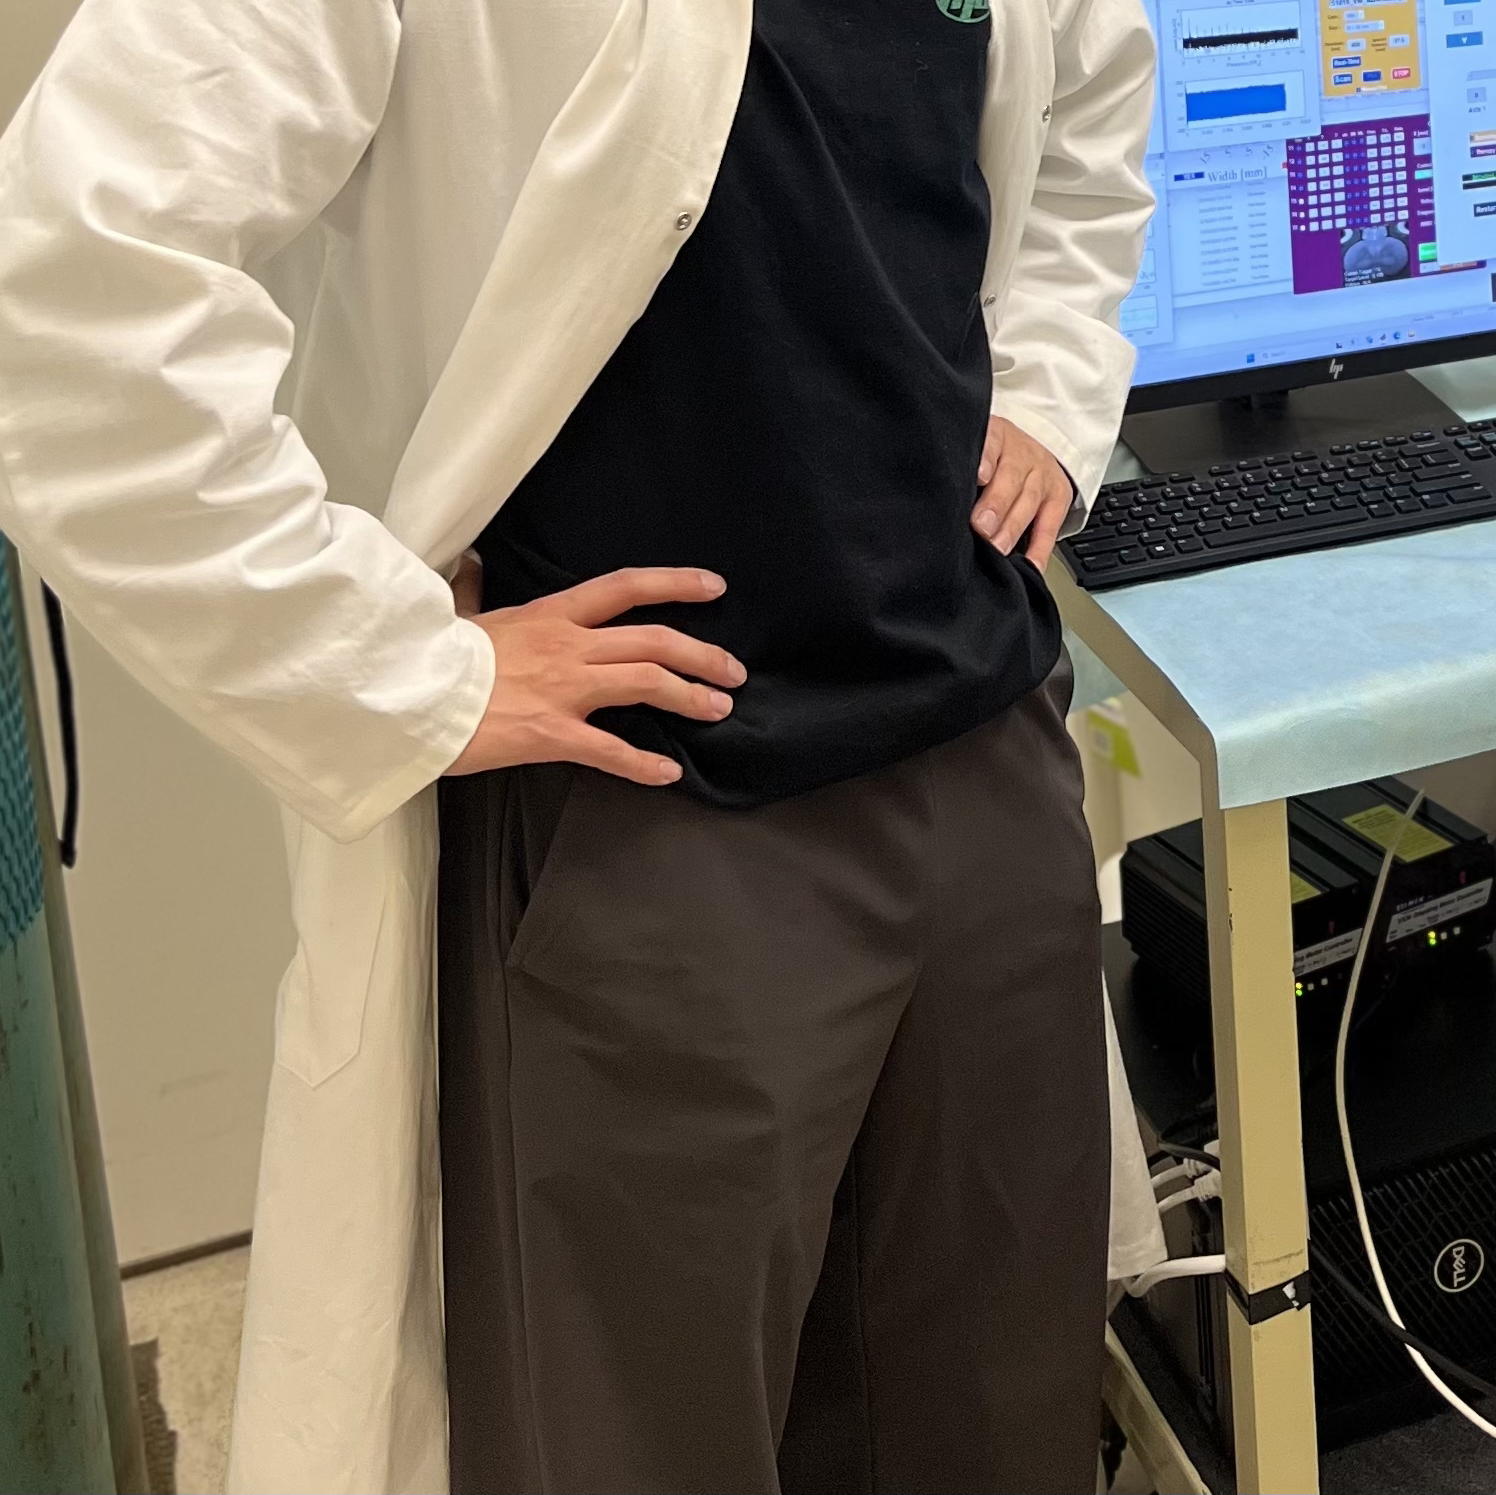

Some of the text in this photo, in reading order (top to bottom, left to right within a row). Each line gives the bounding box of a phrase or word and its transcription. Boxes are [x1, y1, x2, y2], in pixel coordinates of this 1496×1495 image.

[1208, 170, 1238, 182] Width
[1241, 166, 1267, 181] [mm]
[1329, 358, 1344, 380] hp
[1452, 1245, 1466, 1288] DELL
